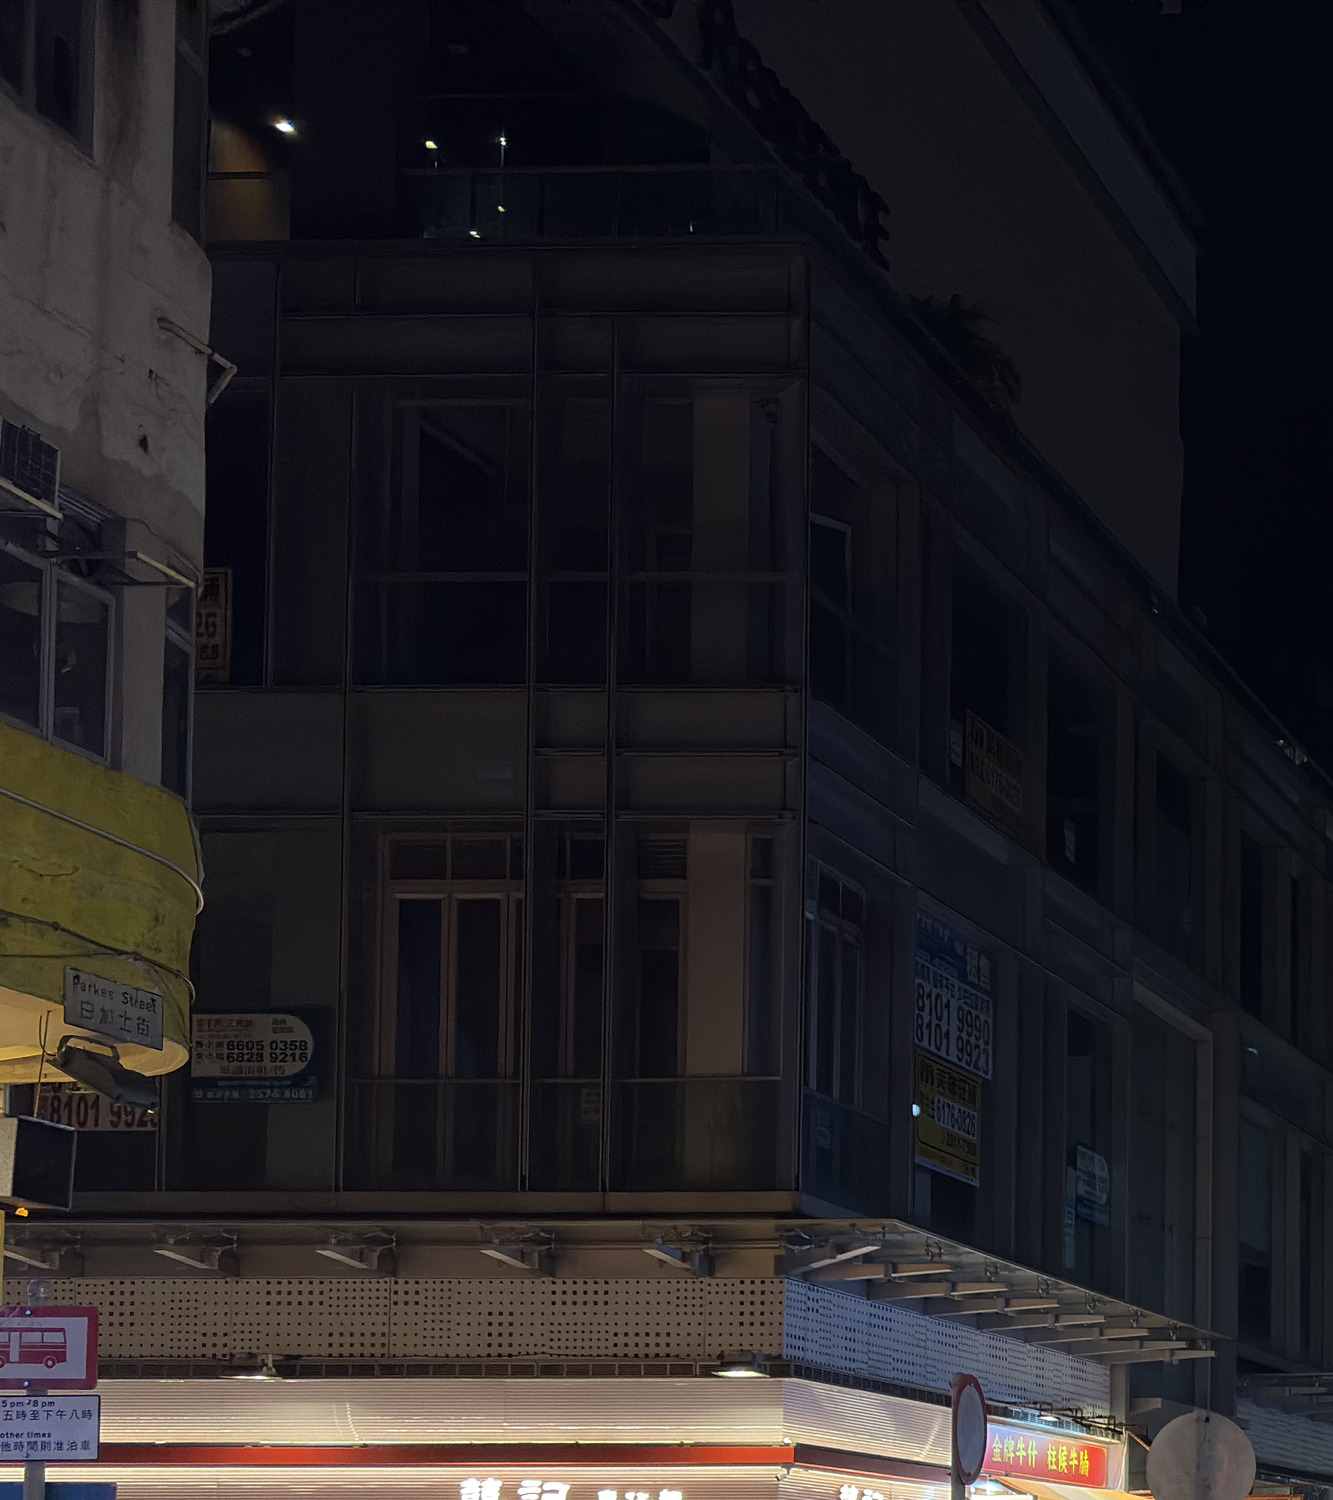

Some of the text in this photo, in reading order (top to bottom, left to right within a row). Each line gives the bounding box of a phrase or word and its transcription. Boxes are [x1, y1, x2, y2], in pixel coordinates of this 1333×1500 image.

[72, 974, 157, 1015] Parkes Street
[916, 982, 951, 1020] 8101
[915, 1012, 951, 1056] 8101
[269, 1052, 309, 1063] 9216
[41, 1401, 55, 1409] pm
[992, 1433, 1038, 1469] 金牌牛什
